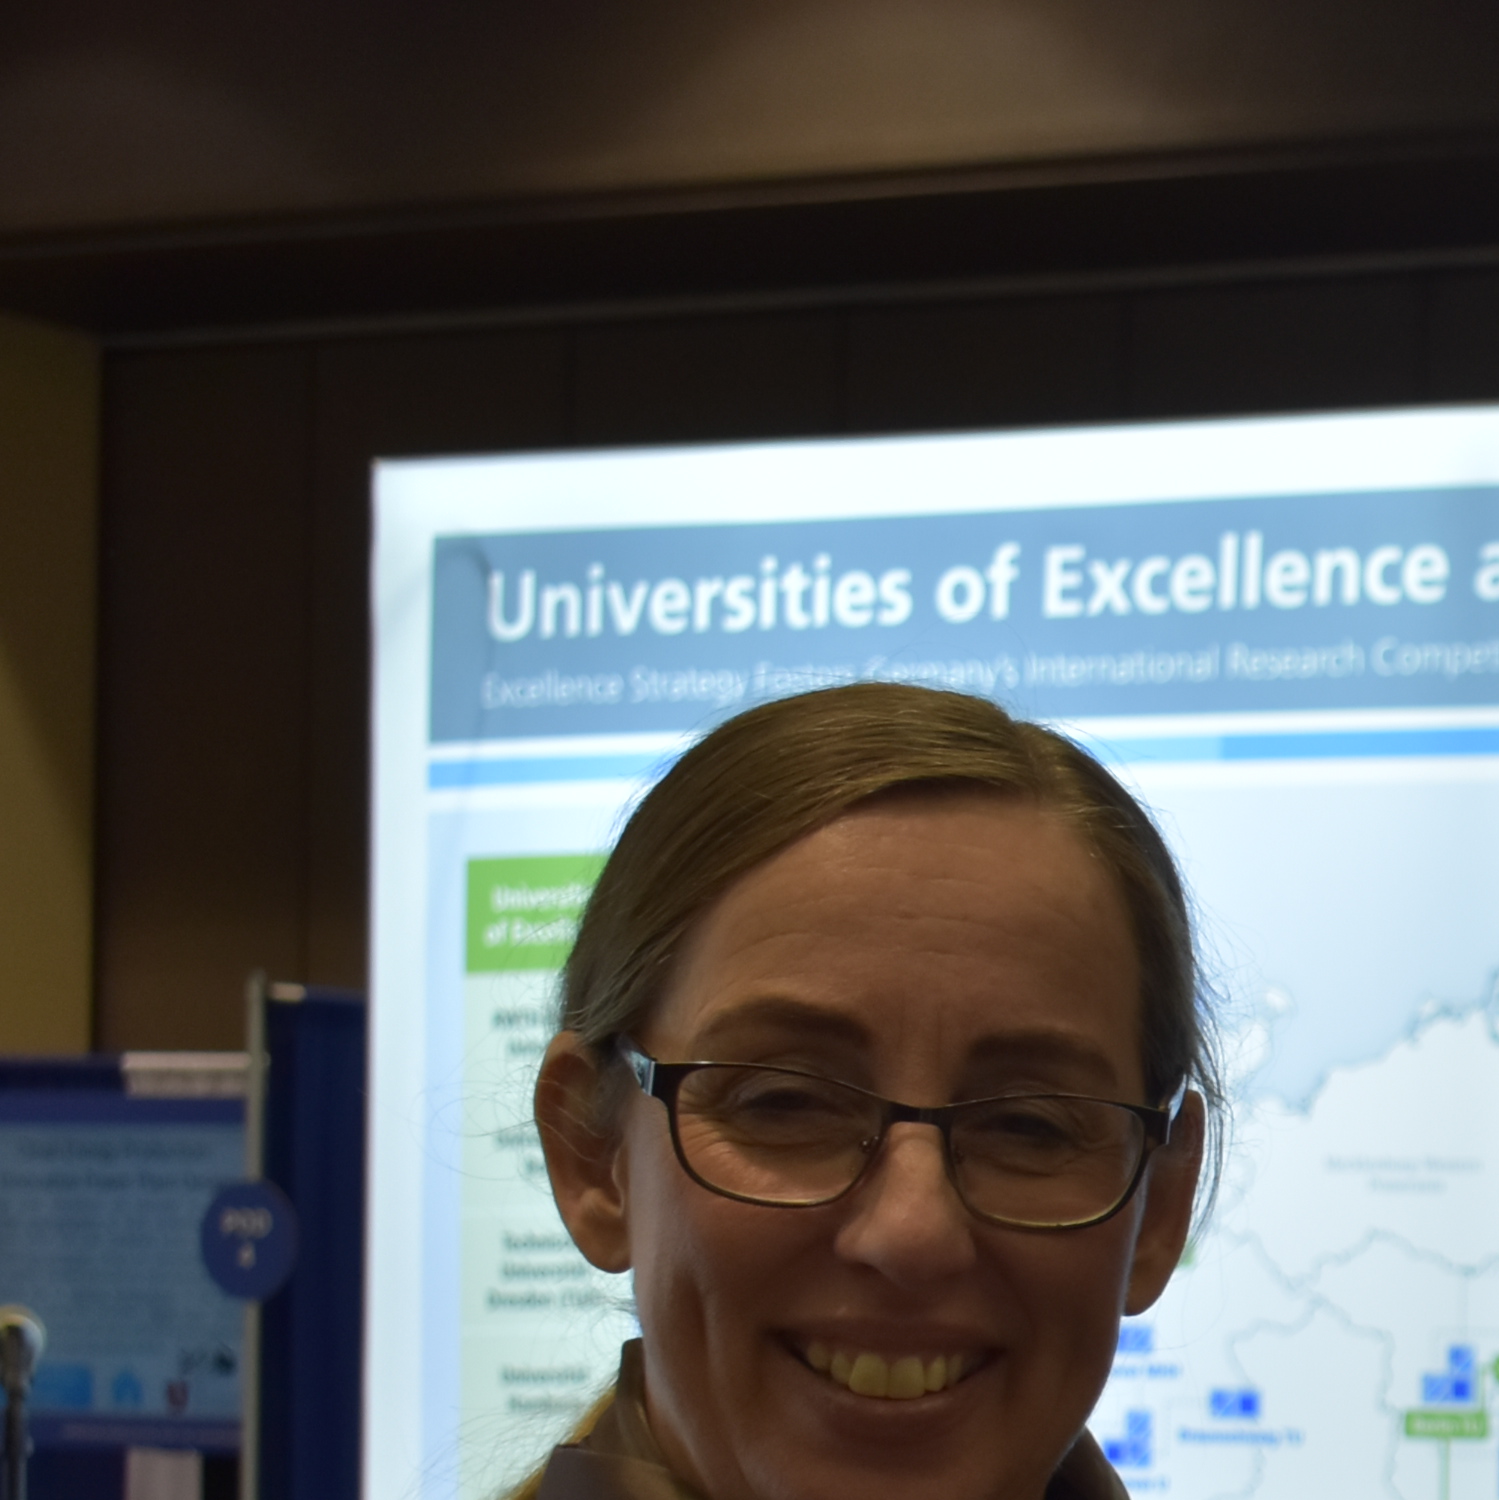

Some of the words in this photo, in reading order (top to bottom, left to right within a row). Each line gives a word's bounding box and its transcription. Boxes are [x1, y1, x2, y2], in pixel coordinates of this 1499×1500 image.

[486, 553, 914, 642] Universities
[934, 541, 1020, 622] of
[1041, 529, 1450, 619] Excellence
